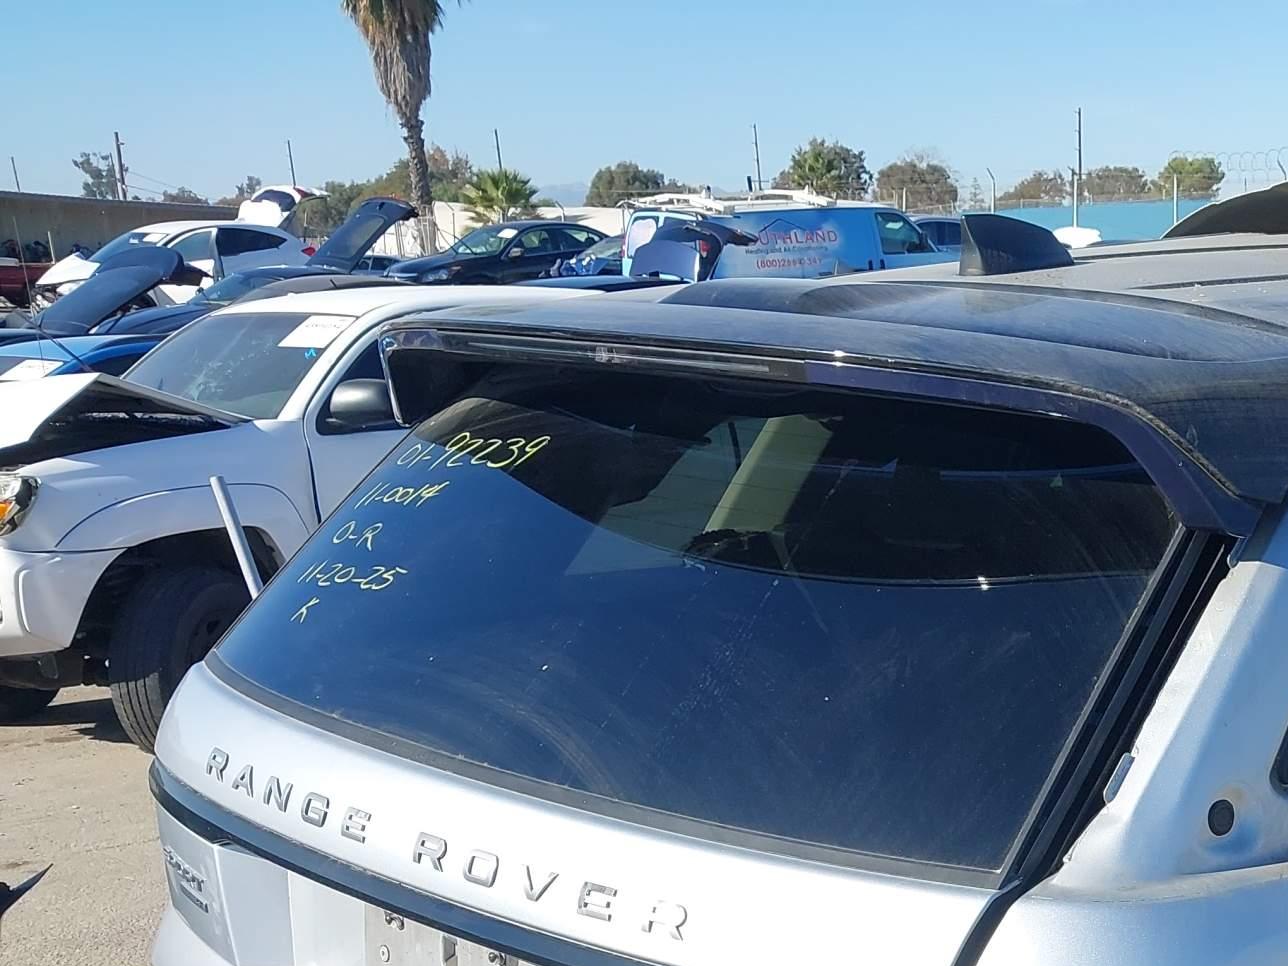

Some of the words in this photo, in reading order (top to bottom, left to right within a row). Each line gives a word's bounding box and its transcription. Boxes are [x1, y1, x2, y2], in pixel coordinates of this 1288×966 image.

[752, 230, 838, 246] UTHLAND
[397, 432, 551, 471] 01-92239
[297, 559, 408, 590] 11-20-25
[205, 746, 373, 845] RANGE
[411, 831, 689, 942] ROVER
